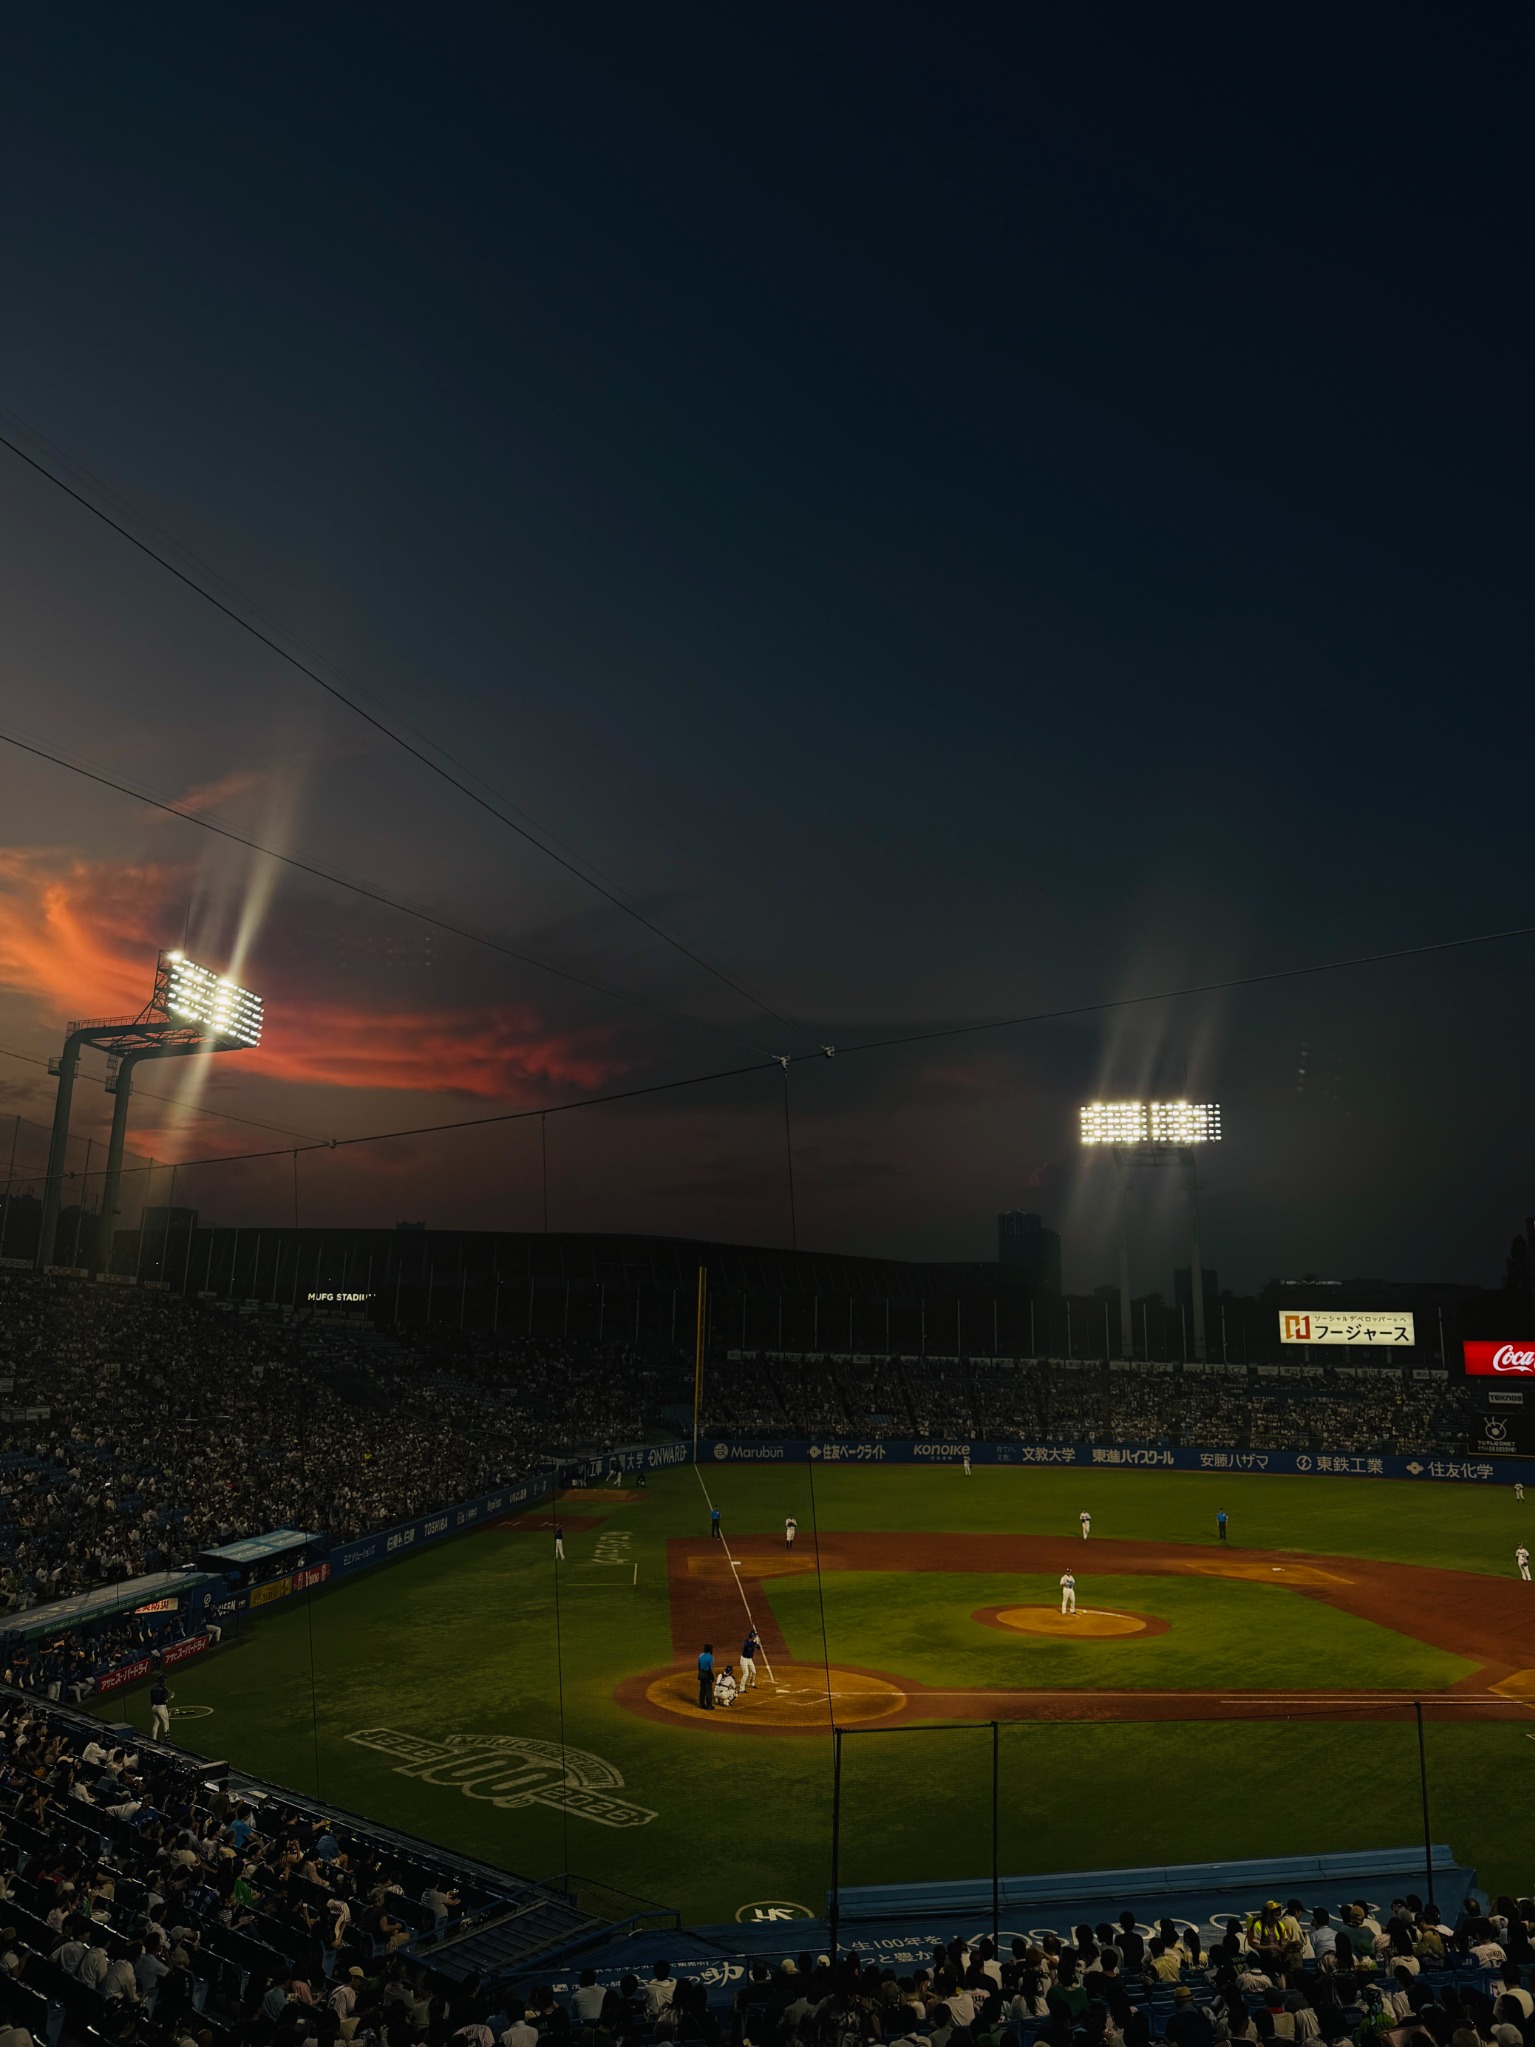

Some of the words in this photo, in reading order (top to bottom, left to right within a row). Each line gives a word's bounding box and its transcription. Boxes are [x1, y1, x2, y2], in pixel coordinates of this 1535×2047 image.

[308, 1293, 334, 1301] MUFG
[1315, 1324, 1409, 1341] フージャース
[1489, 1394, 1522, 1402] TEKNOS
[648, 1445, 687, 1467] ONWARD
[731, 1445, 784, 1458] Marubun
[823, 1444, 886, 1460] 住友ベークライト
[1022, 1446, 1075, 1462] 文教大学
[1092, 1449, 1174, 1465] 東進ハイスクール
[1200, 1453, 1268, 1469] 安藤ハザマ
[1316, 1456, 1384, 1474] 東鉄工業
[1428, 1461, 1494, 1479] 住友化学
[424, 1517, 448, 1537] TOSHIBA
[165, 1639, 207, 1664] アサヒスーパードライ
[101, 1661, 149, 1691] アサヒスーパードライ
[398, 1746, 571, 1799] 100
[540, 1788, 639, 1821] 2026
